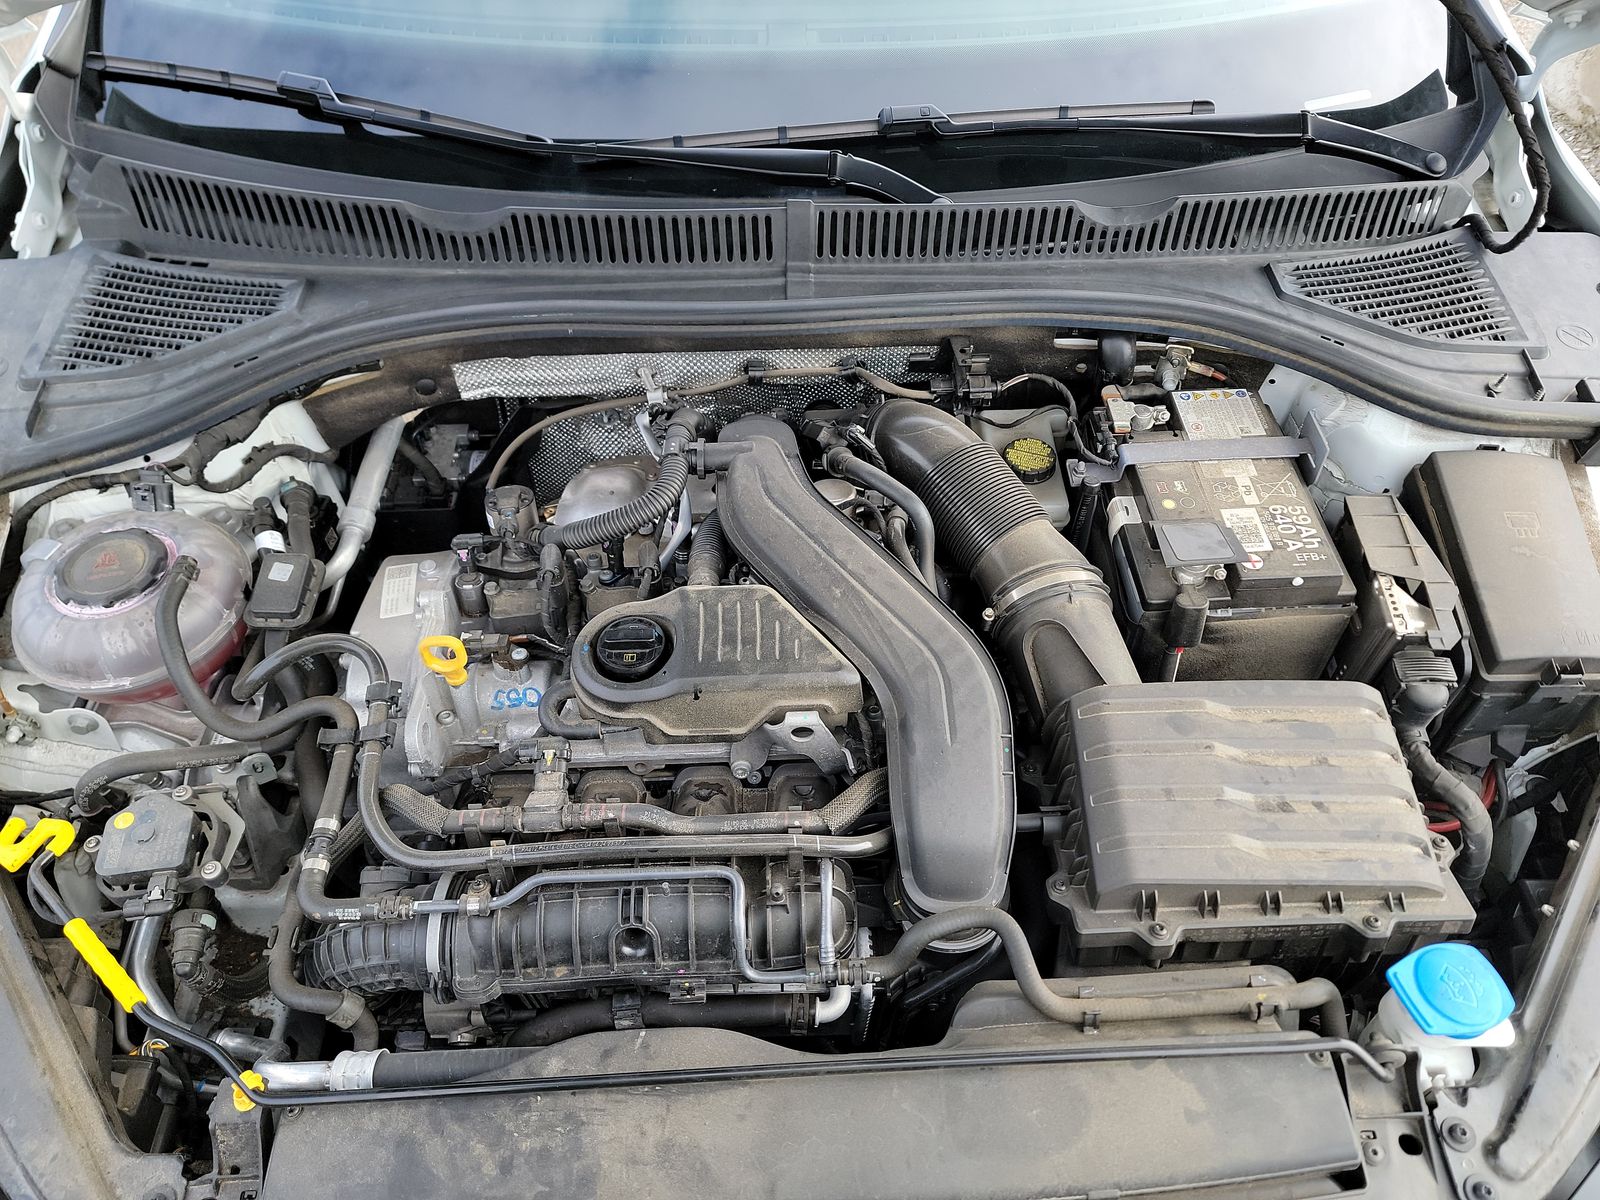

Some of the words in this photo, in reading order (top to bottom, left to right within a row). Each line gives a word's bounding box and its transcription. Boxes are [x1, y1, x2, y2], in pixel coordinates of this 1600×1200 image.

[1241, 484, 1252, 496] Pb
[1269, 504, 1297, 534] 640
[1283, 538, 1304, 551] A
[1288, 504, 1321, 549] 59Ah
[1296, 553, 1328, 562] EFB+
